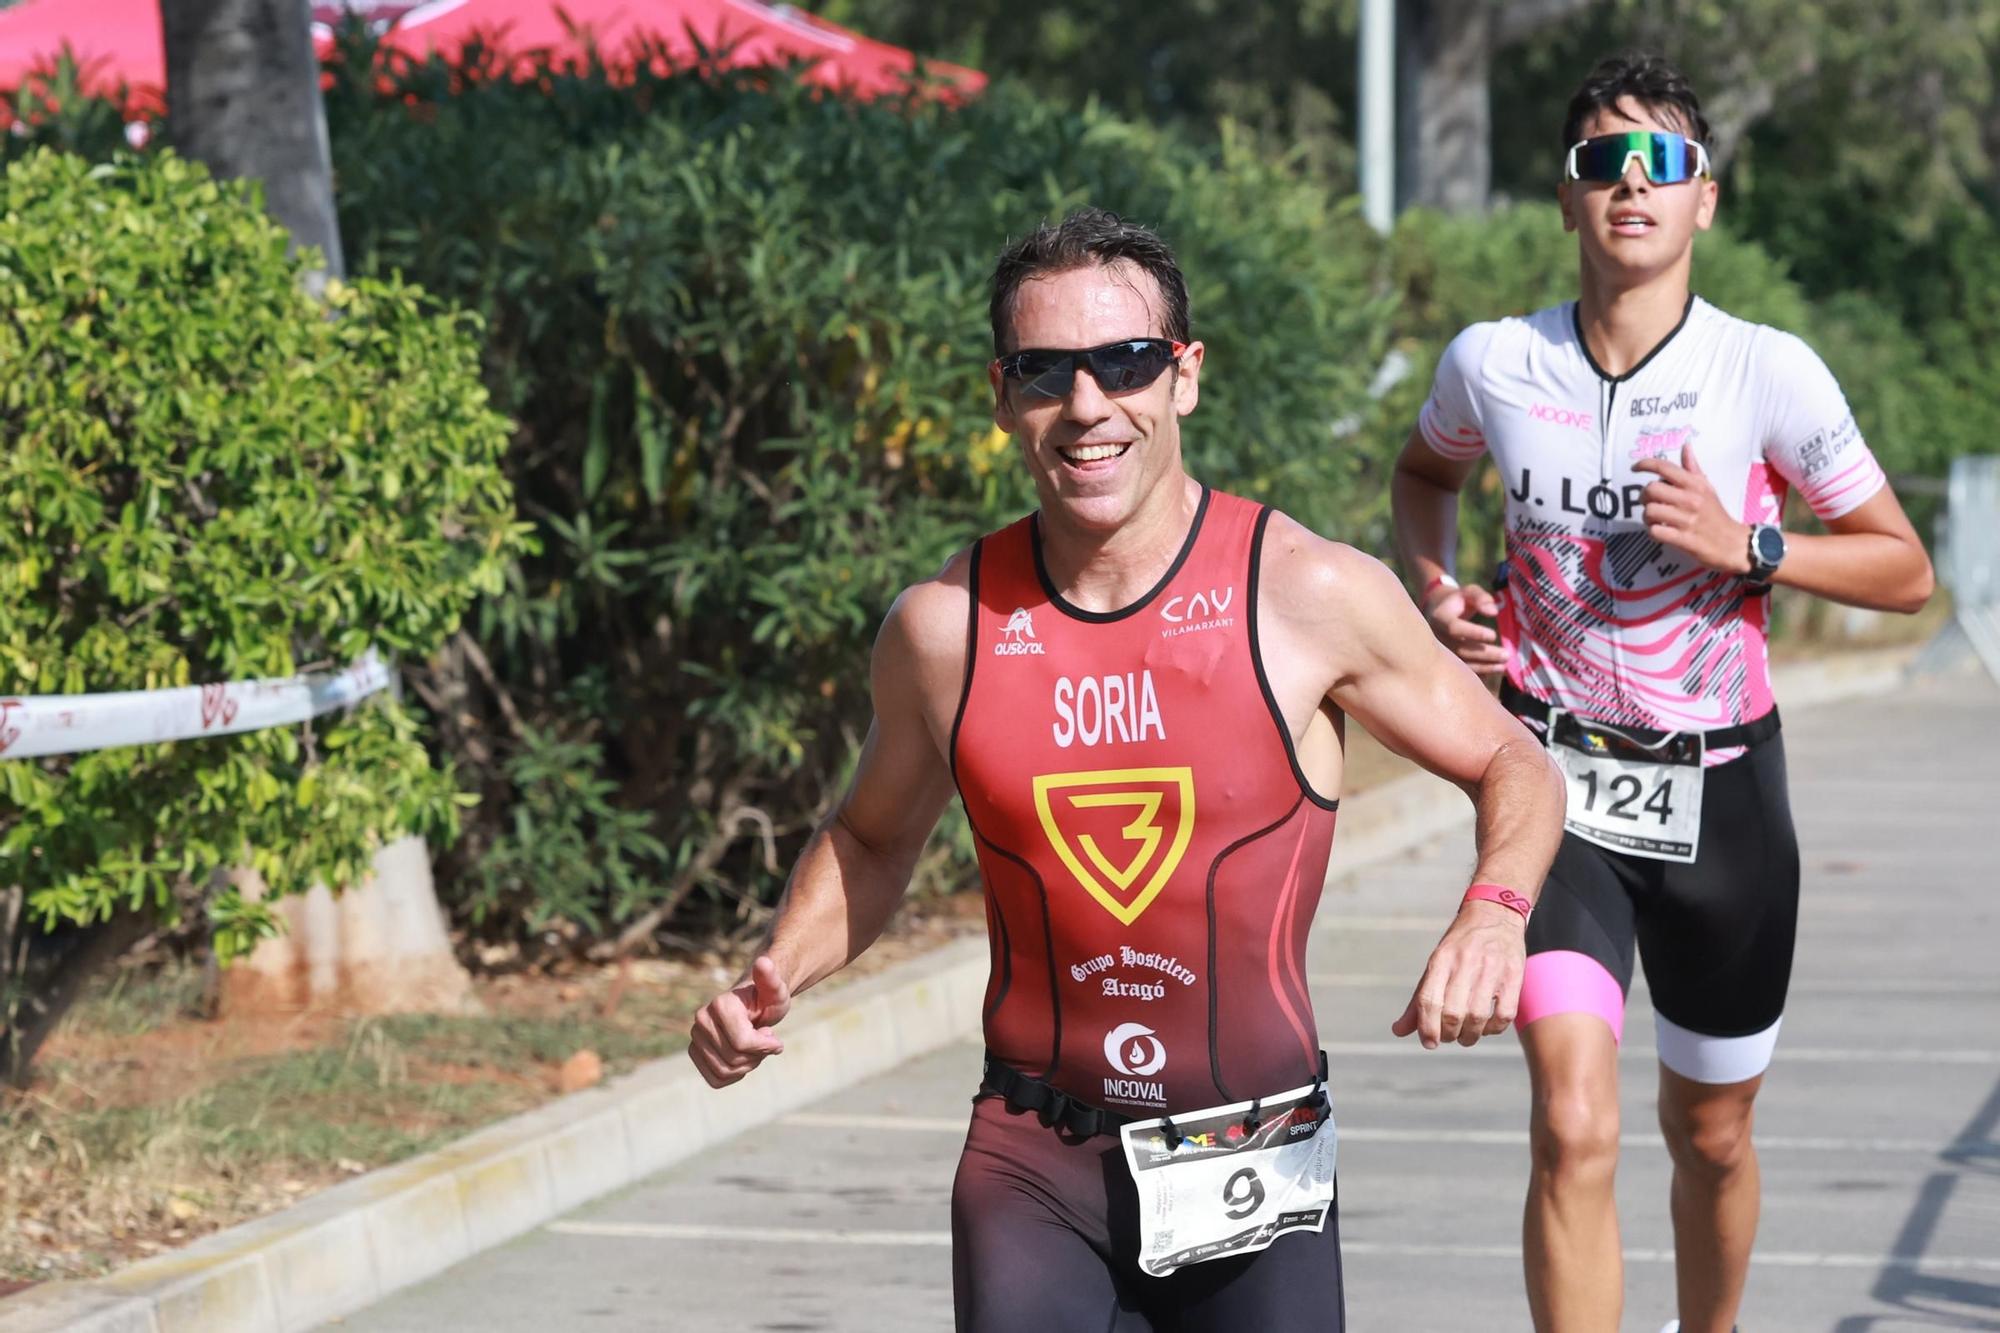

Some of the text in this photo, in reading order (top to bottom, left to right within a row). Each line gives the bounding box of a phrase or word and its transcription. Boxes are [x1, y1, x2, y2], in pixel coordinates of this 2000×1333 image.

[1630, 396, 1661, 417] BEST
[1673, 392, 1697, 410] YOU
[1511, 468, 1644, 520] J. LÓP
[1160, 586, 1233, 622] CAV
[1161, 618, 1233, 639] VILAMARXANT
[1053, 669, 1166, 748] SORIA
[1577, 769, 1673, 826] 124
[1071, 945, 1196, 986] Grupo Hostelero
[1102, 979, 1165, 1001] Aragó
[1104, 1078, 1167, 1101] INCOVAL
[1289, 1121, 1318, 1136] SPRINT
[1223, 1167, 1266, 1220] 9
